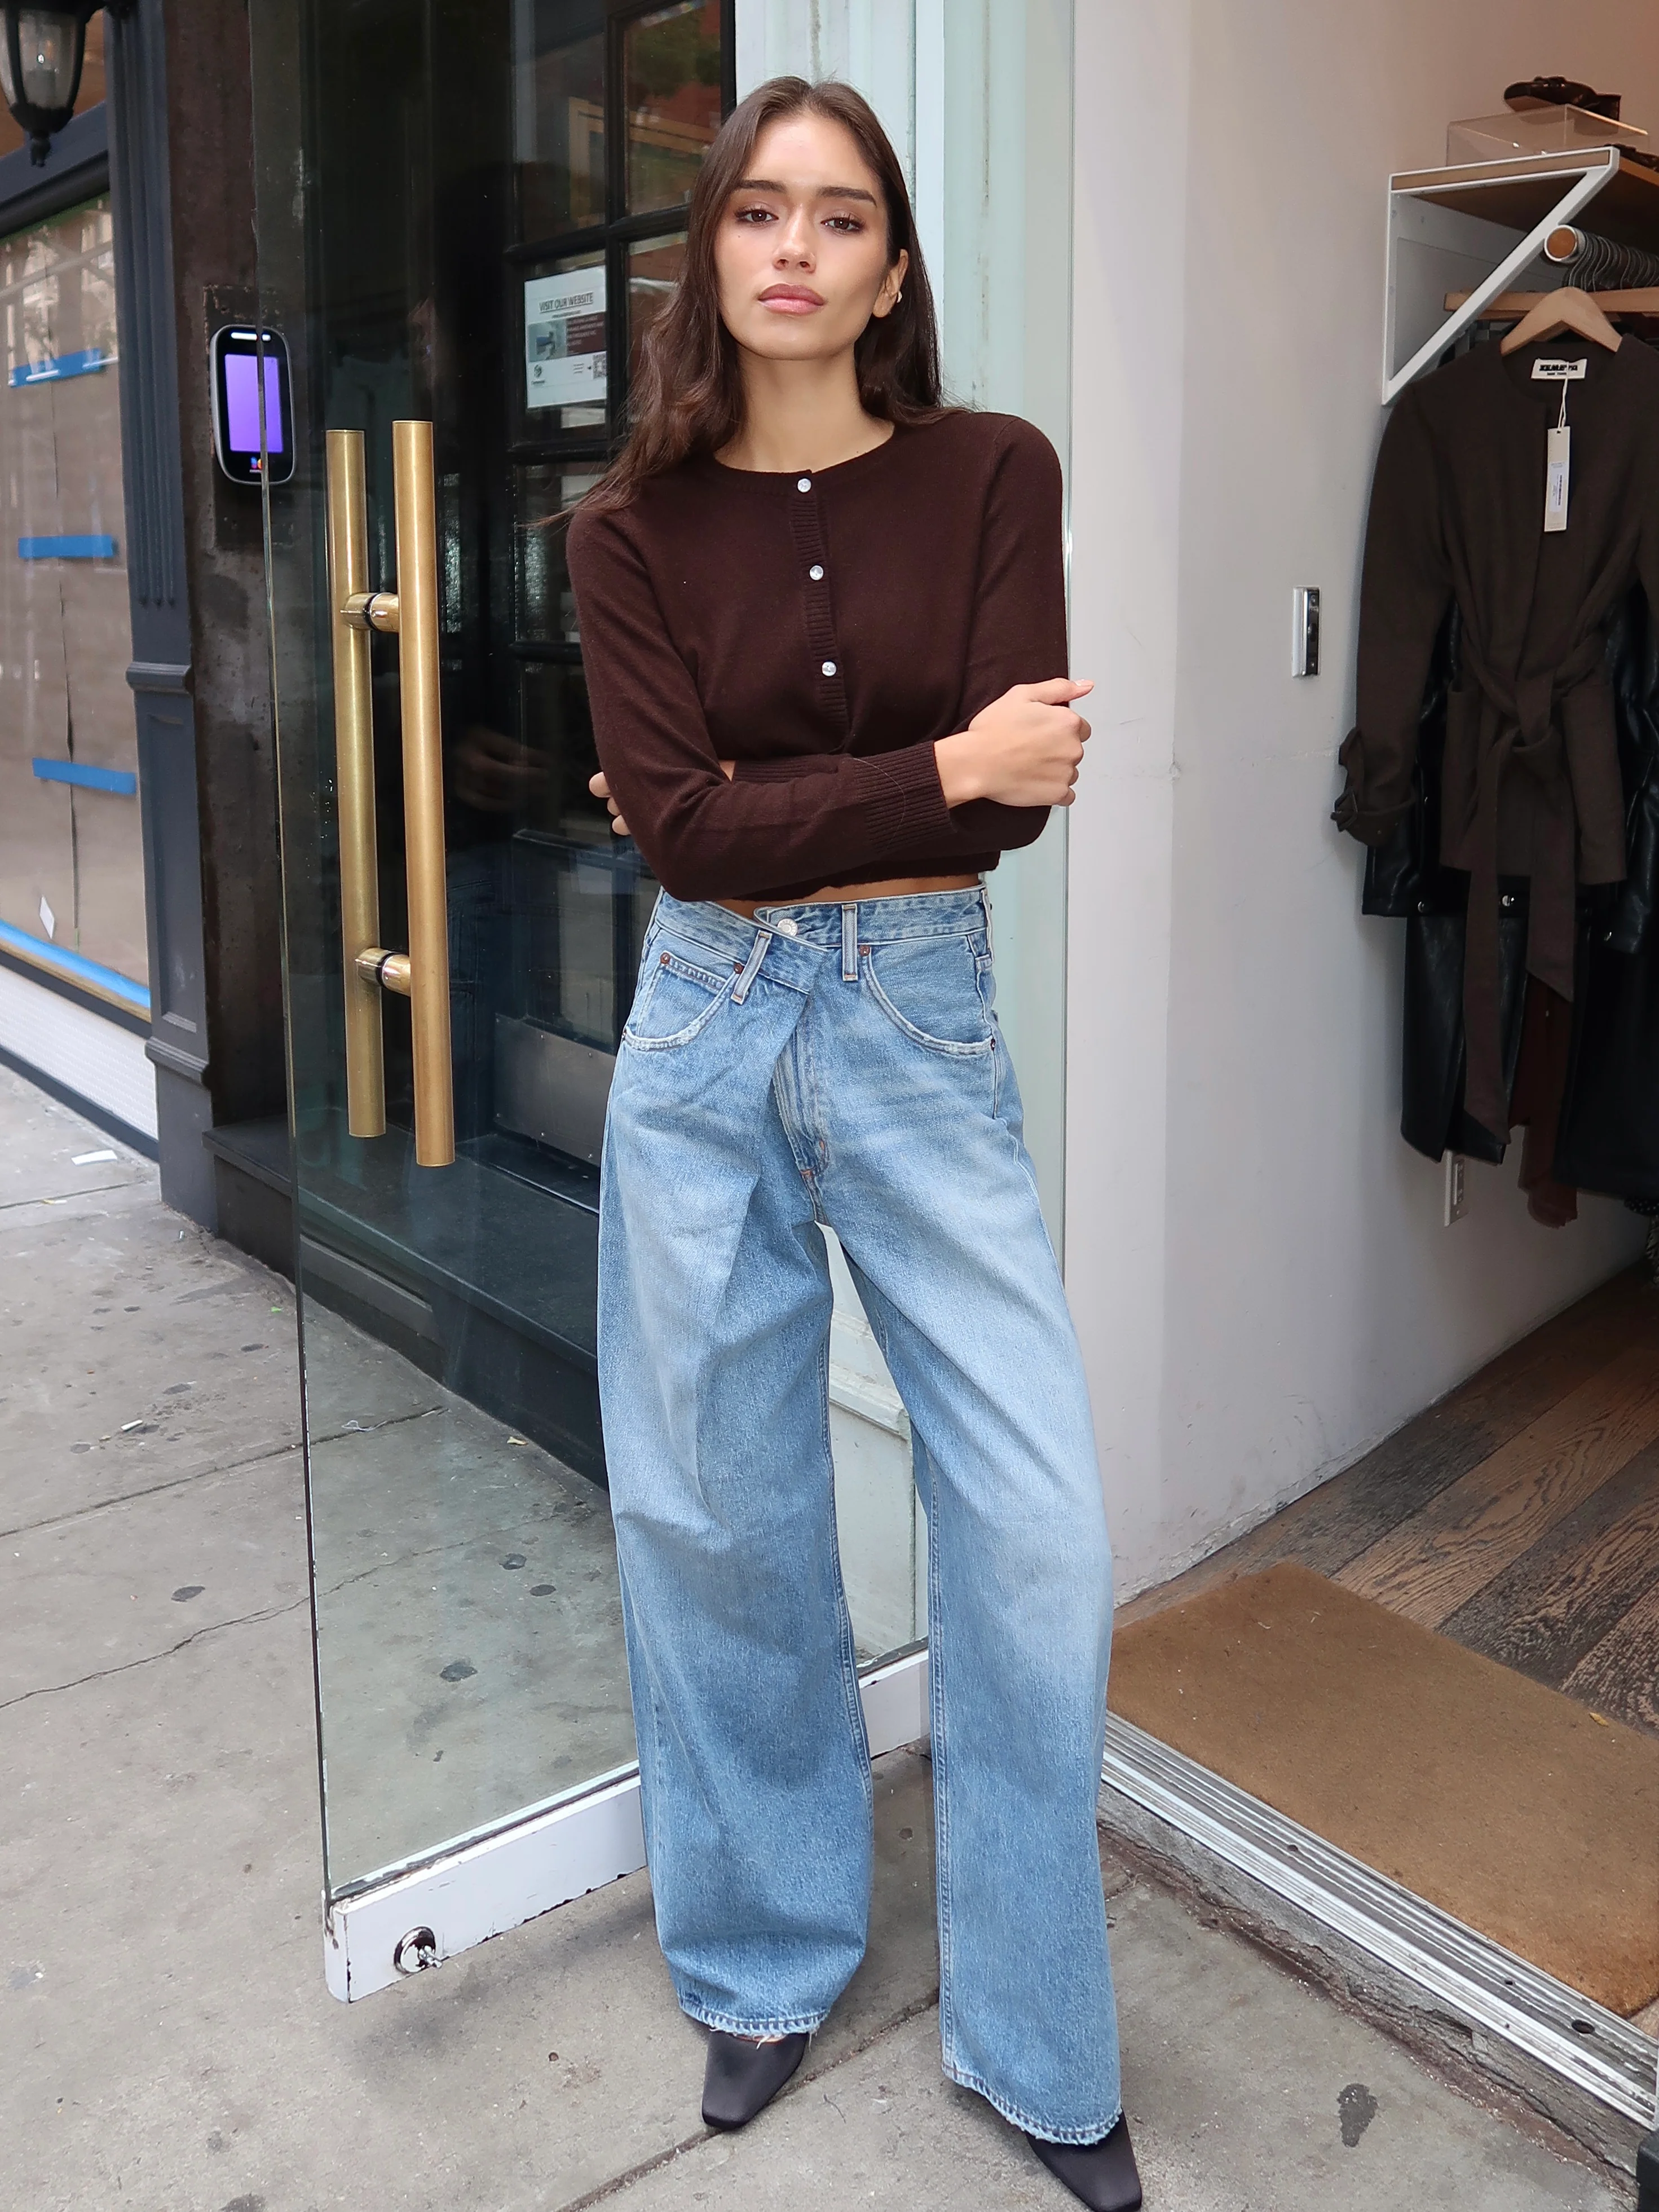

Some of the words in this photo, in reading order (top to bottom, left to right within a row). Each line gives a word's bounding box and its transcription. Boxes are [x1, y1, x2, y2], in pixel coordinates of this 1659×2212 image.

[539, 299, 554, 311] VISIT
[554, 298, 568, 309] OUR
[568, 292, 593, 306] WEBSITE
